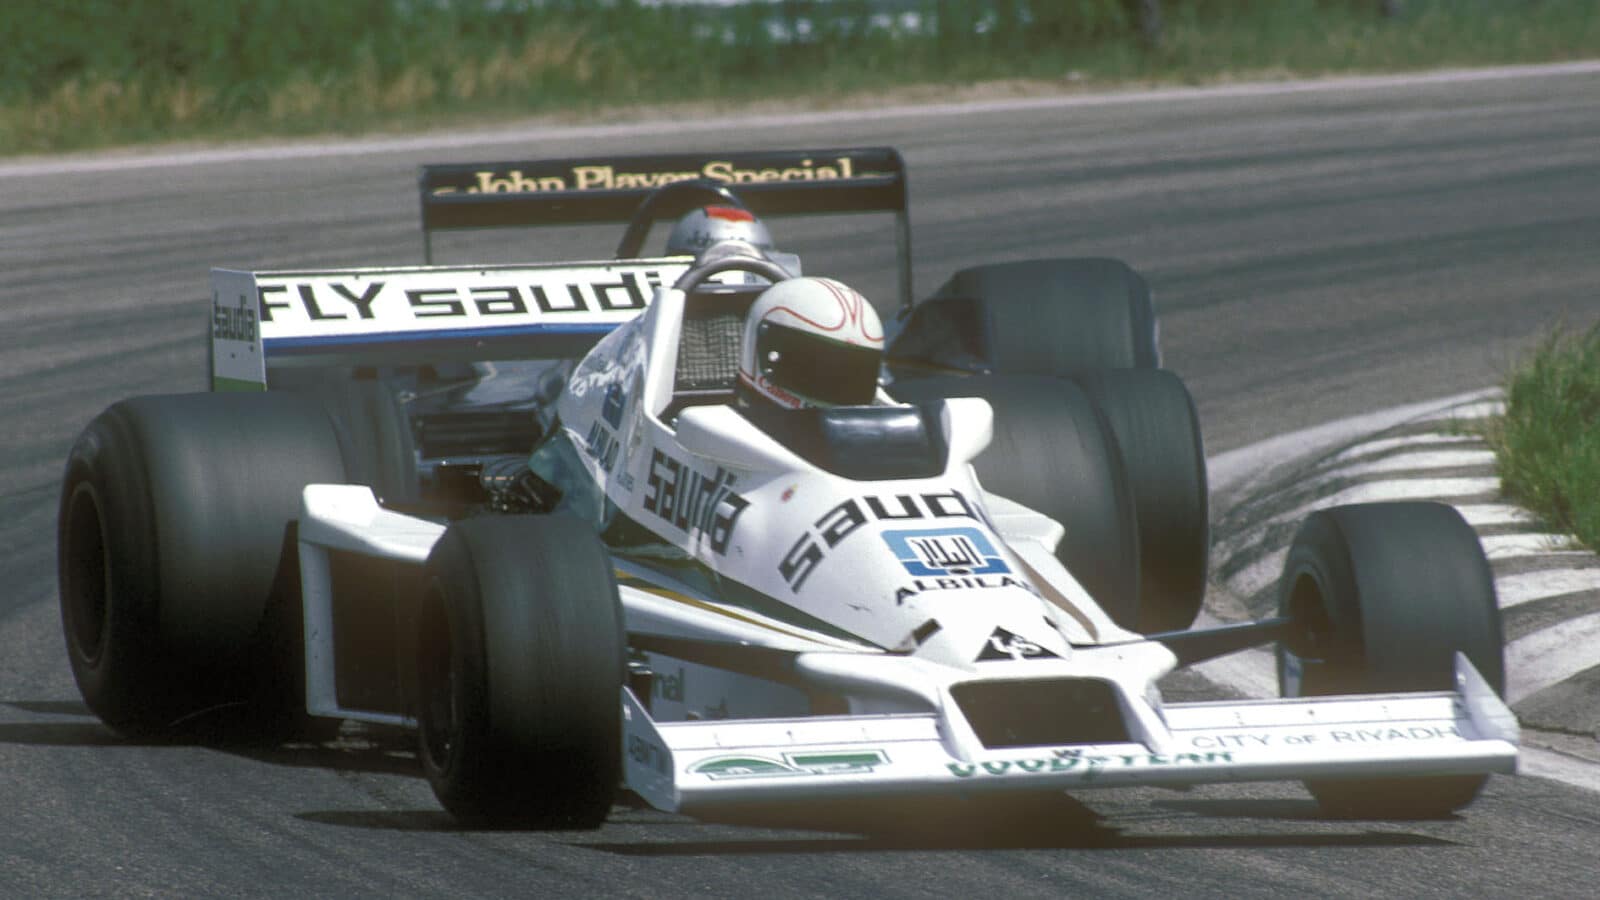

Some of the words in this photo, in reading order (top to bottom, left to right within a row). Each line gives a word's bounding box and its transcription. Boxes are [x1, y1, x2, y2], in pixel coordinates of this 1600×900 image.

[466, 170, 567, 195] John
[702, 157, 853, 185] Special
[257, 282, 386, 322] FLY
[405, 271, 662, 317] saudi
[643, 447, 751, 556] saudia
[895, 575, 1026, 607] ALBILA
[1190, 732, 1272, 750] CITY
